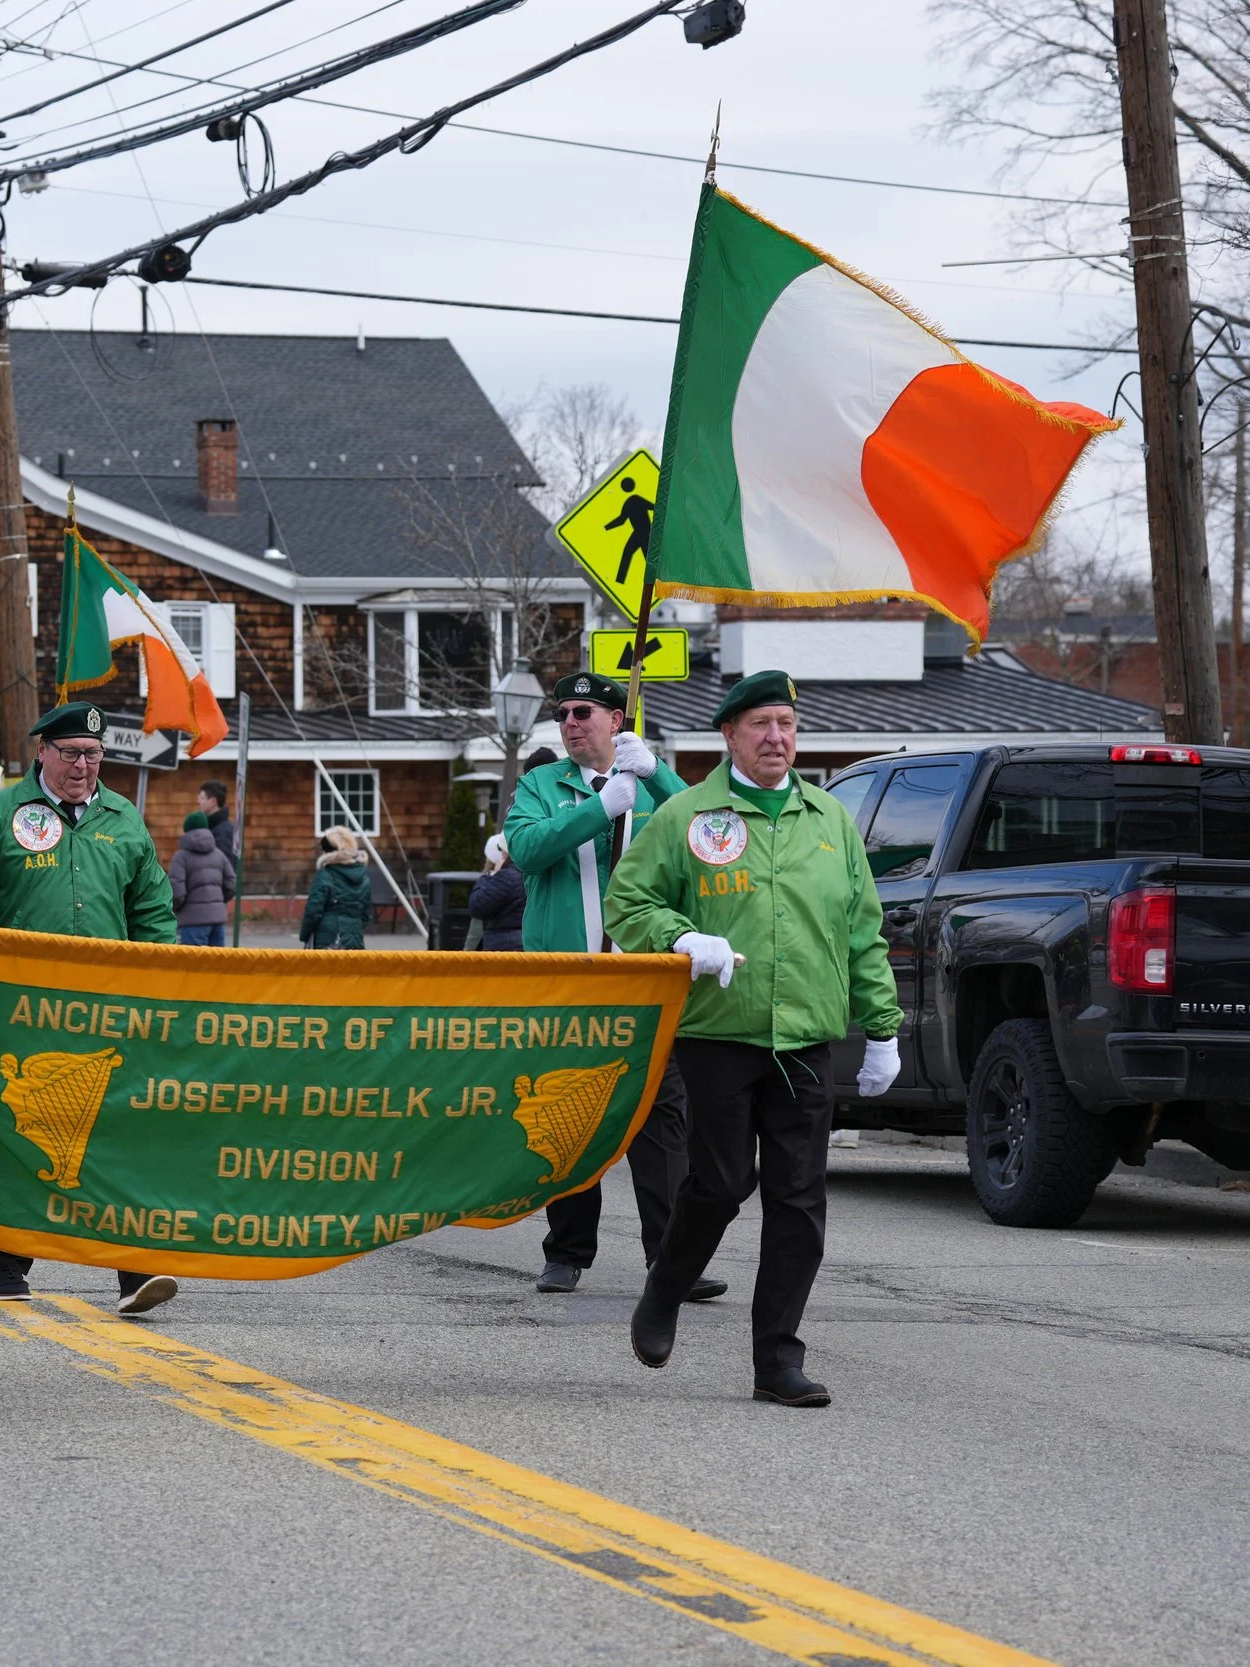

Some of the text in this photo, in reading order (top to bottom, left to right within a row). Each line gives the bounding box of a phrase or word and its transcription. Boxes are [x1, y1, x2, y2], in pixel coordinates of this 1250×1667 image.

[113, 731, 142, 748] WAY
[24, 853, 59, 870] A.O.H.
[699, 868, 758, 898] A.O.H.
[9, 995, 636, 1050] ANCIENT ORDER OF HIBERNIANS
[1180, 1002, 1250, 1014] SILVER
[130, 1078, 503, 1118] JOSEPH DUELK JR.
[217, 1147, 403, 1181] DIVISION 1
[46, 1193, 198, 1242] ORANGE
[212, 1213, 362, 1248] COUNTY,
[372, 1211, 447, 1244] NEW
